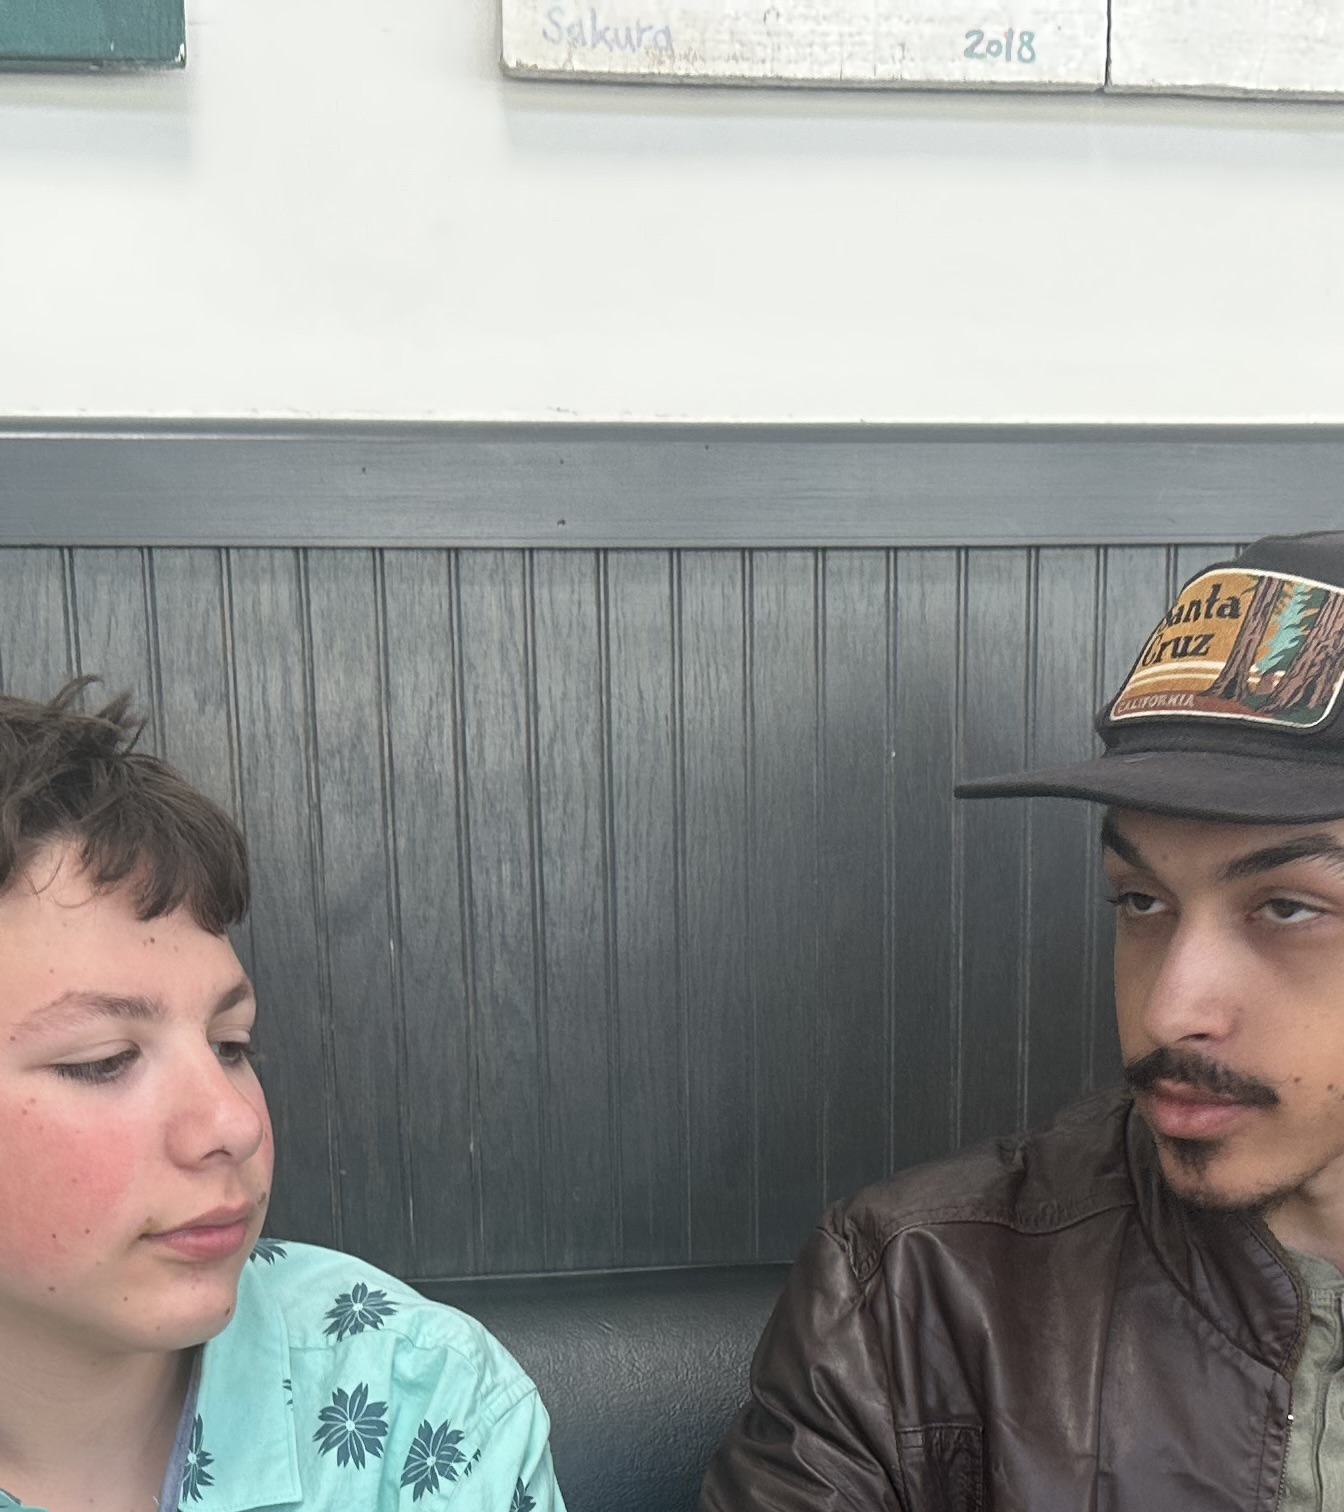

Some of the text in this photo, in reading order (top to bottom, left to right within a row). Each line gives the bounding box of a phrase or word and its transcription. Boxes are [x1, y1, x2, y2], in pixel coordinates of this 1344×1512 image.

[963, 28, 1036, 64] 2018
[1164, 583, 1242, 626] anta
[1141, 632, 1215, 668] Cruz
[1117, 694, 1195, 714] CALIFORNIA
